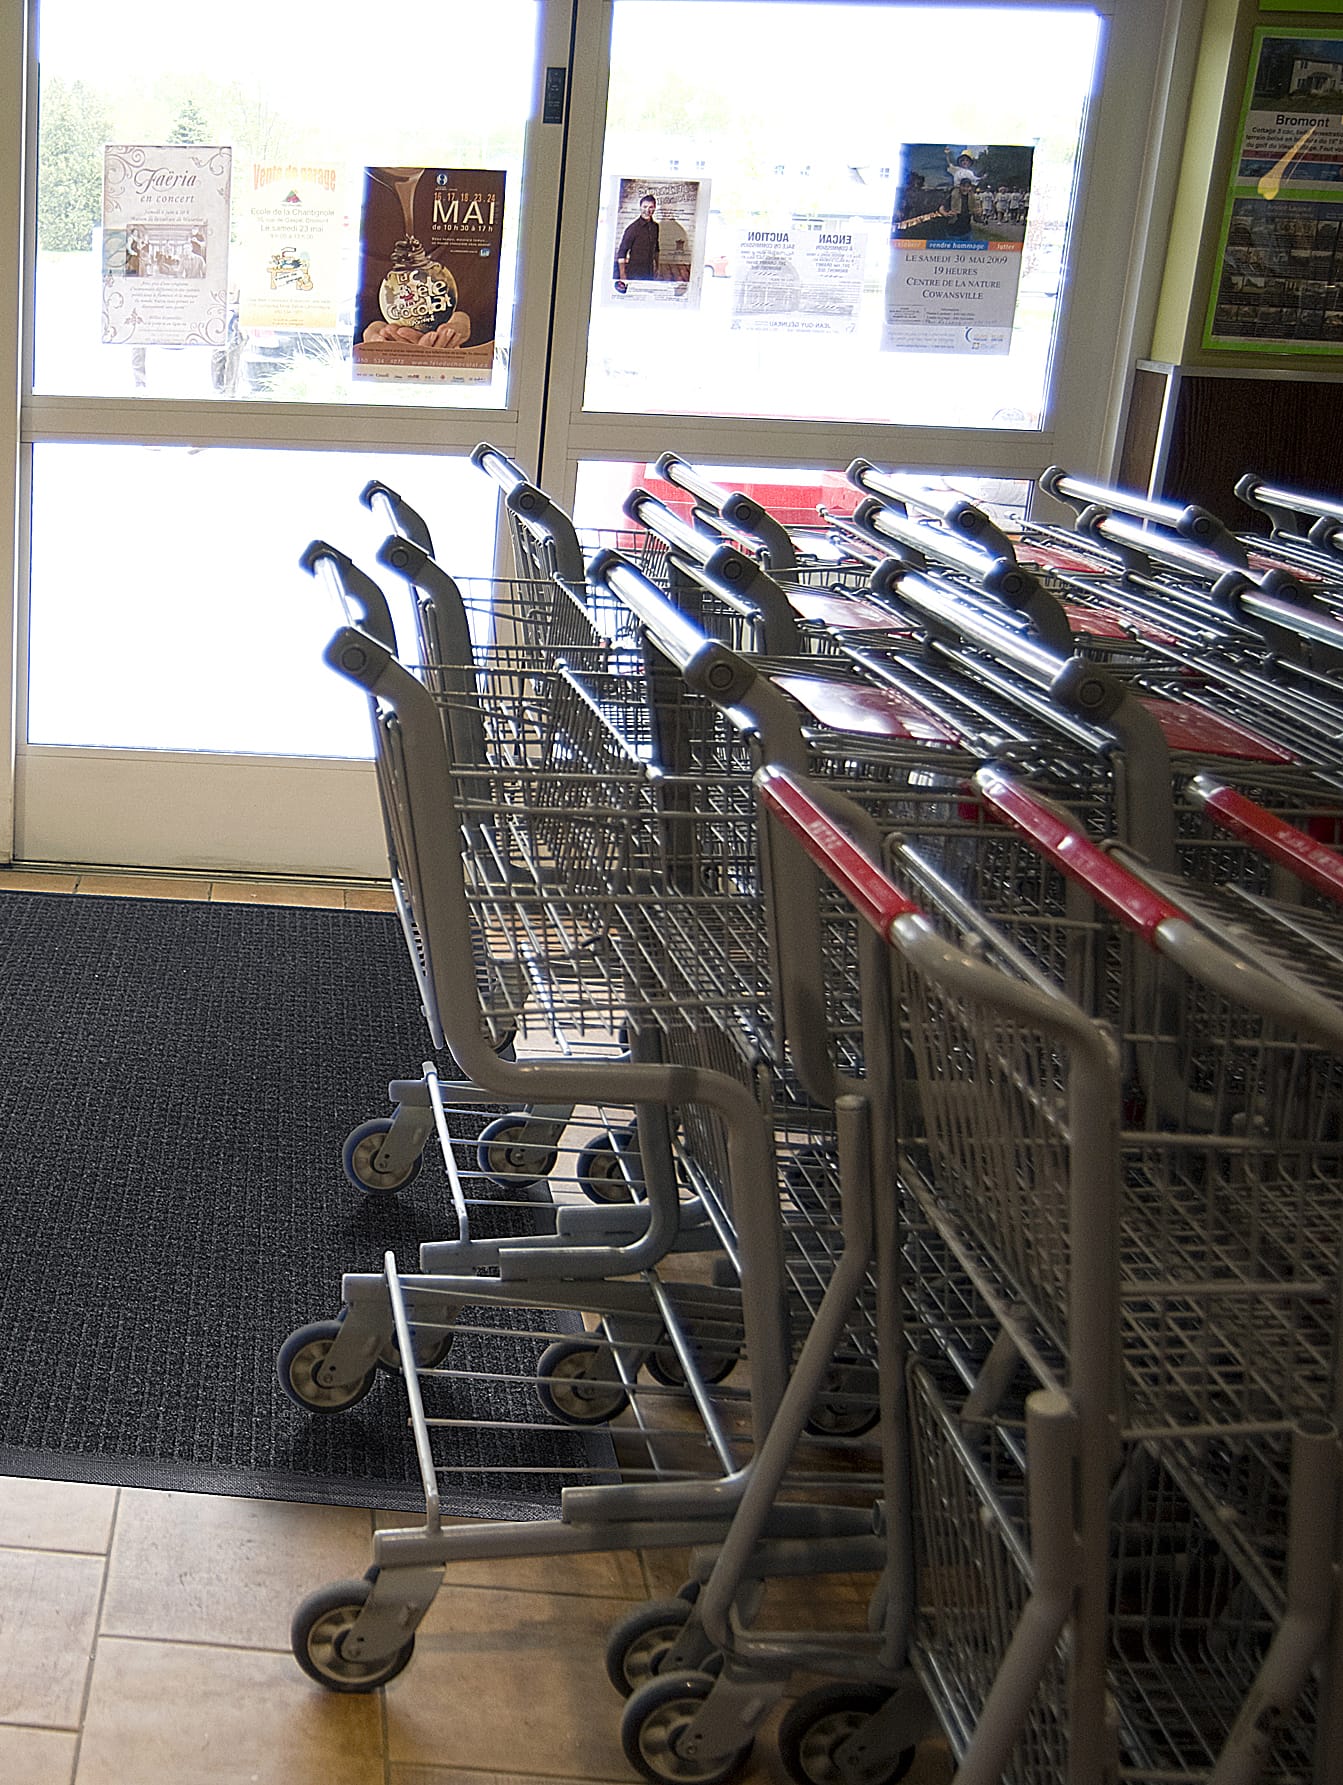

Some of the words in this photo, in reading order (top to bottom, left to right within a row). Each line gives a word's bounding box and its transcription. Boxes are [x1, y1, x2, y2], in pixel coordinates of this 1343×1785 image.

[1276, 114, 1330, 127] Bromont
[134, 168, 197, 194] Faëria
[254, 164, 282, 190] Vente
[286, 165, 298, 180] de
[301, 168, 336, 192] garage
[140, 194, 152, 203] en
[156, 194, 194, 204] concert
[434, 192, 442, 201] 16
[448, 192, 456, 201] 17
[460, 193, 469, 202] 18
[474, 194, 482, 202] 23
[487, 194, 496, 203] 24
[292, 209, 334, 217] Chantignole
[433, 200, 495, 224] MAI
[952, 242, 985, 250] hommage
[906, 254, 916, 262] LE
[954, 254, 966, 263] 30
[968, 256, 985, 264] MAI
[986, 255, 1008, 264] 2009
[934, 266, 944, 275] 19
[946, 268, 978, 276] HEURES
[906, 276, 941, 286] CENTRE
[955, 280, 966, 288] LA
[968, 280, 1001, 288] NATURE
[922, 289, 984, 300] COWANSVILLE
